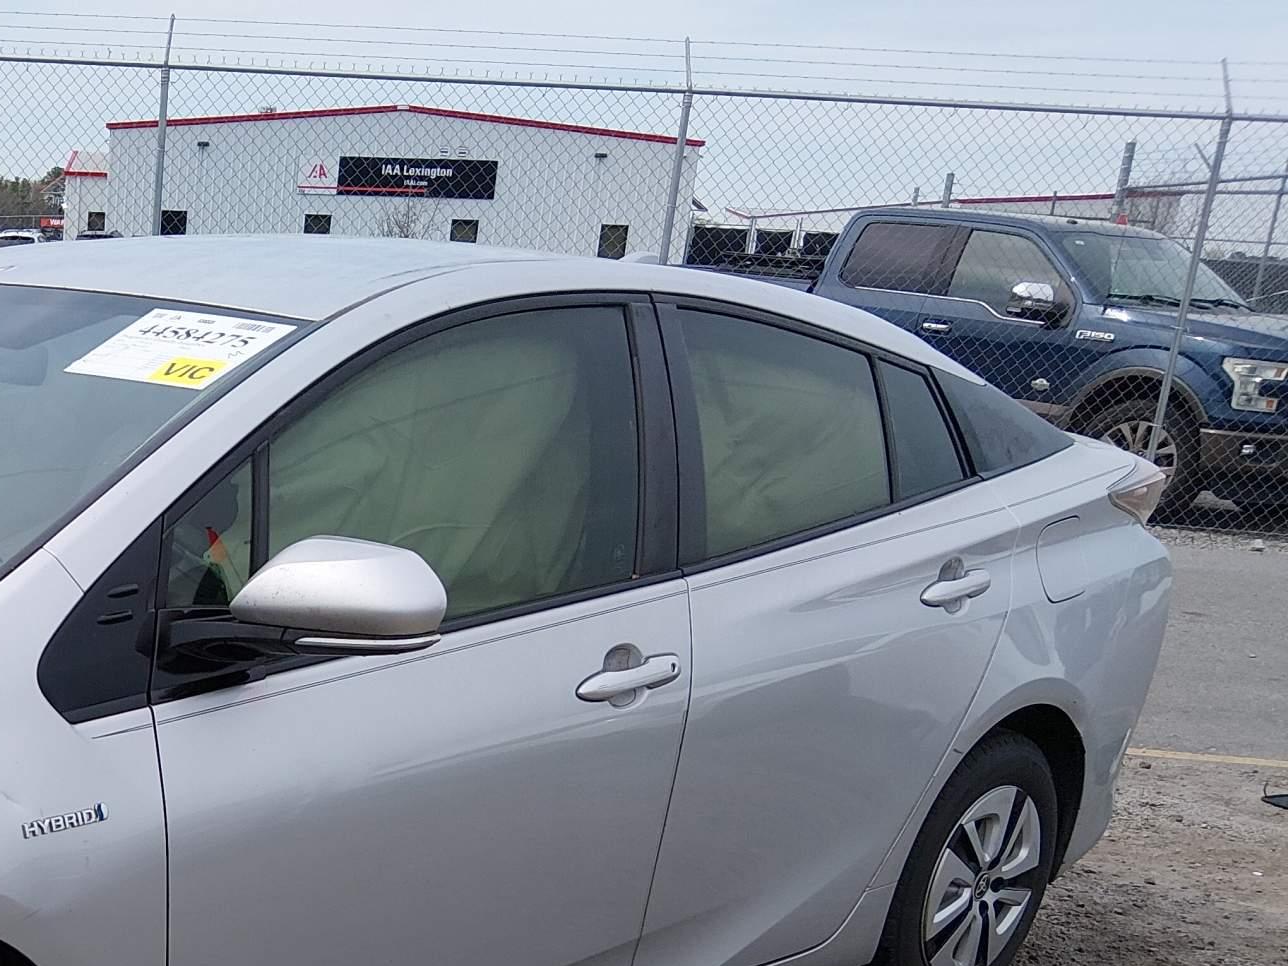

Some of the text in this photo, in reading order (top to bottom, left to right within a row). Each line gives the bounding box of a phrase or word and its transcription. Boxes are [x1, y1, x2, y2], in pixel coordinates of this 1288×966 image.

[381, 164, 453, 179] IAA Lexington
[139, 324, 257, 348] 44584275
[164, 362, 215, 380] VIC
[21, 808, 98, 840] HYBRID
